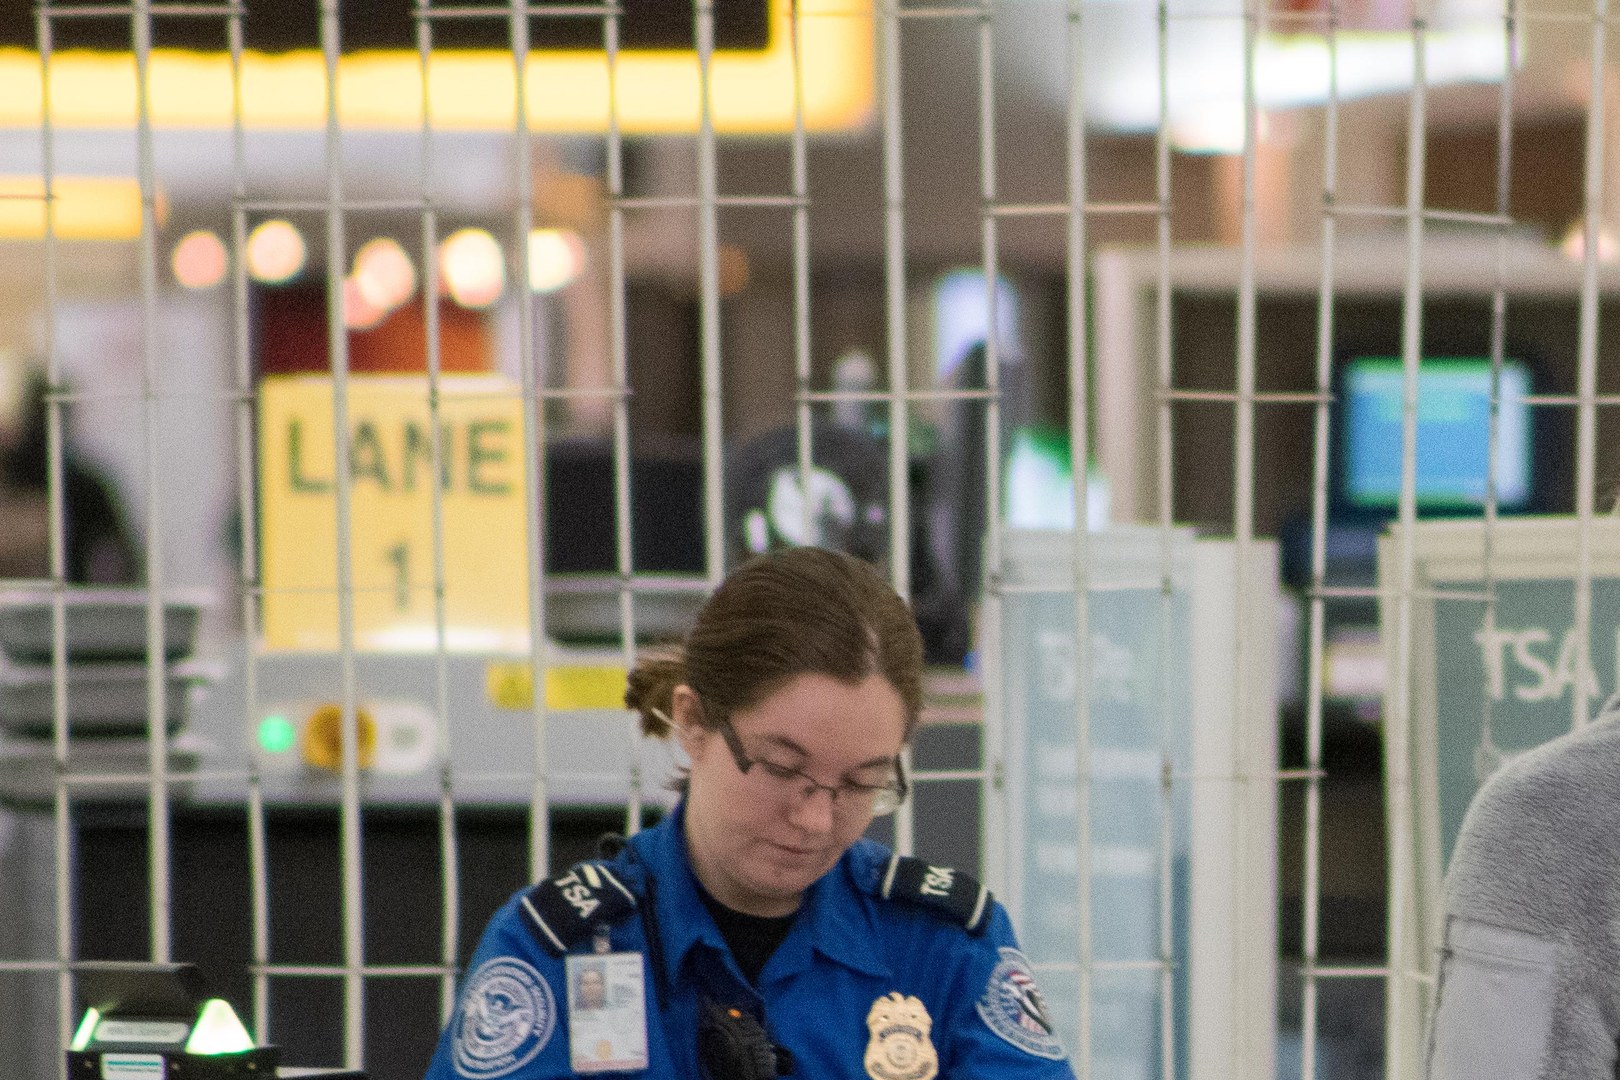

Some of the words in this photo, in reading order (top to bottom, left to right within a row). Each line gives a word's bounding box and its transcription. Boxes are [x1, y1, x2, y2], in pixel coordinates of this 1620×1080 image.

[287, 416, 513, 496] LANE
[384, 541, 412, 614] 1
[1475, 626, 1598, 700] TSA
[554, 869, 601, 919] TSA
[920, 866, 955, 897] TSA
